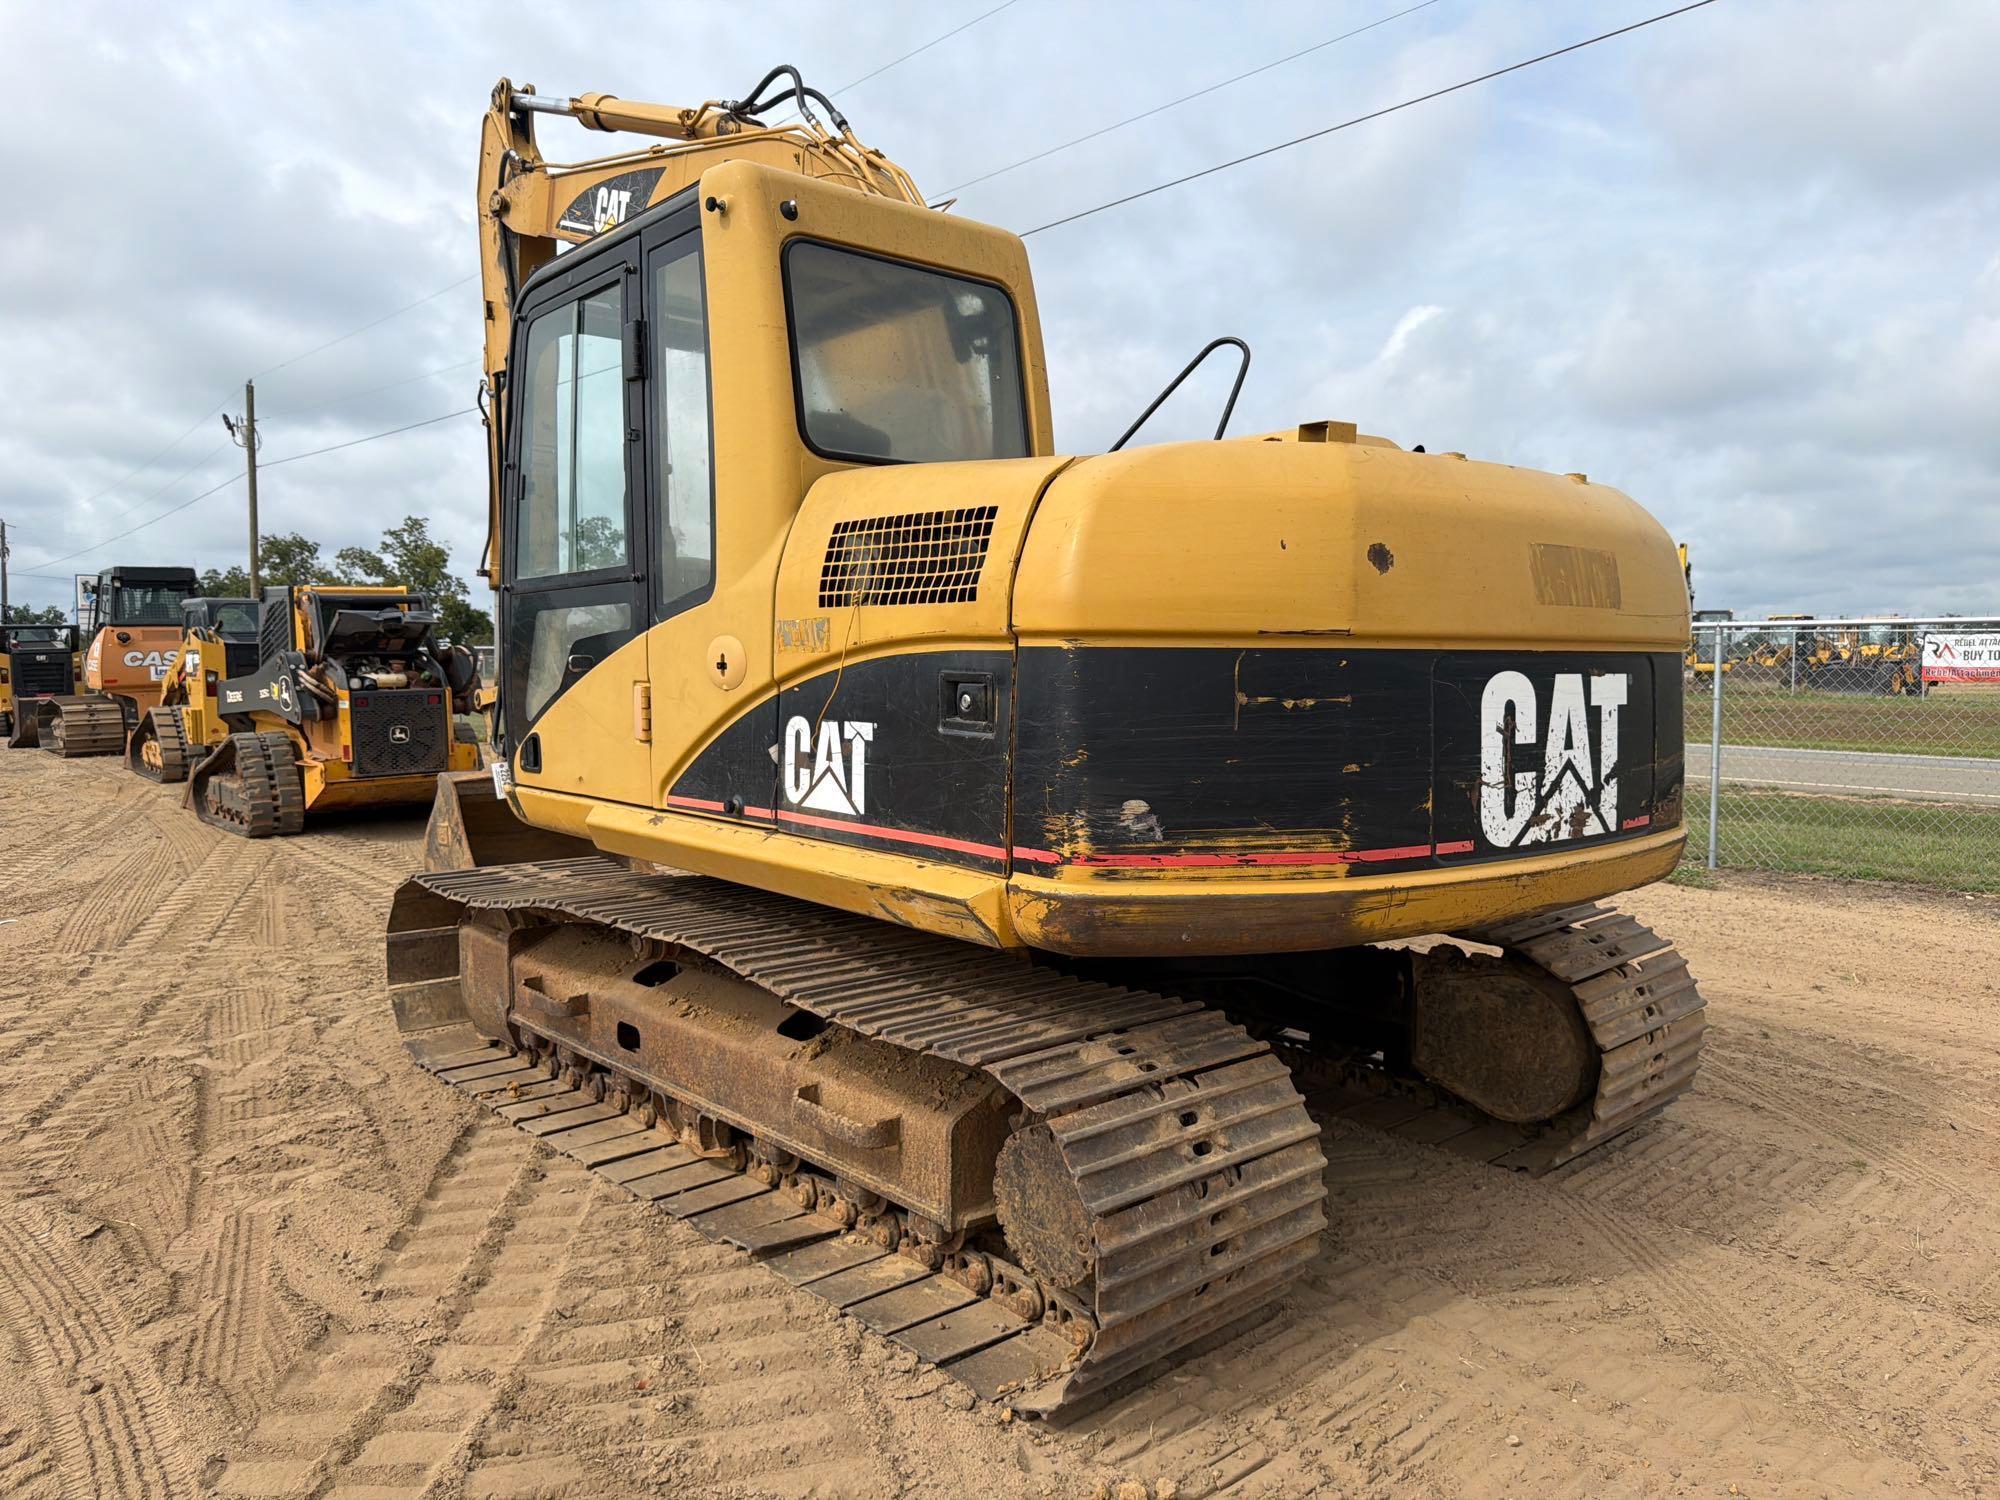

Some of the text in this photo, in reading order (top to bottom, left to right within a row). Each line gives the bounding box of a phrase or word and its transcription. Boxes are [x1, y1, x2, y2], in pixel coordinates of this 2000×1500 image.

[593, 186, 632, 233] CAT
[1954, 639, 1976, 647] REBEL
[1963, 650, 1984, 661] BUY
[123, 651, 178, 667] CAS
[784, 715, 874, 816] CAT
[1480, 670, 1628, 848] CAT
